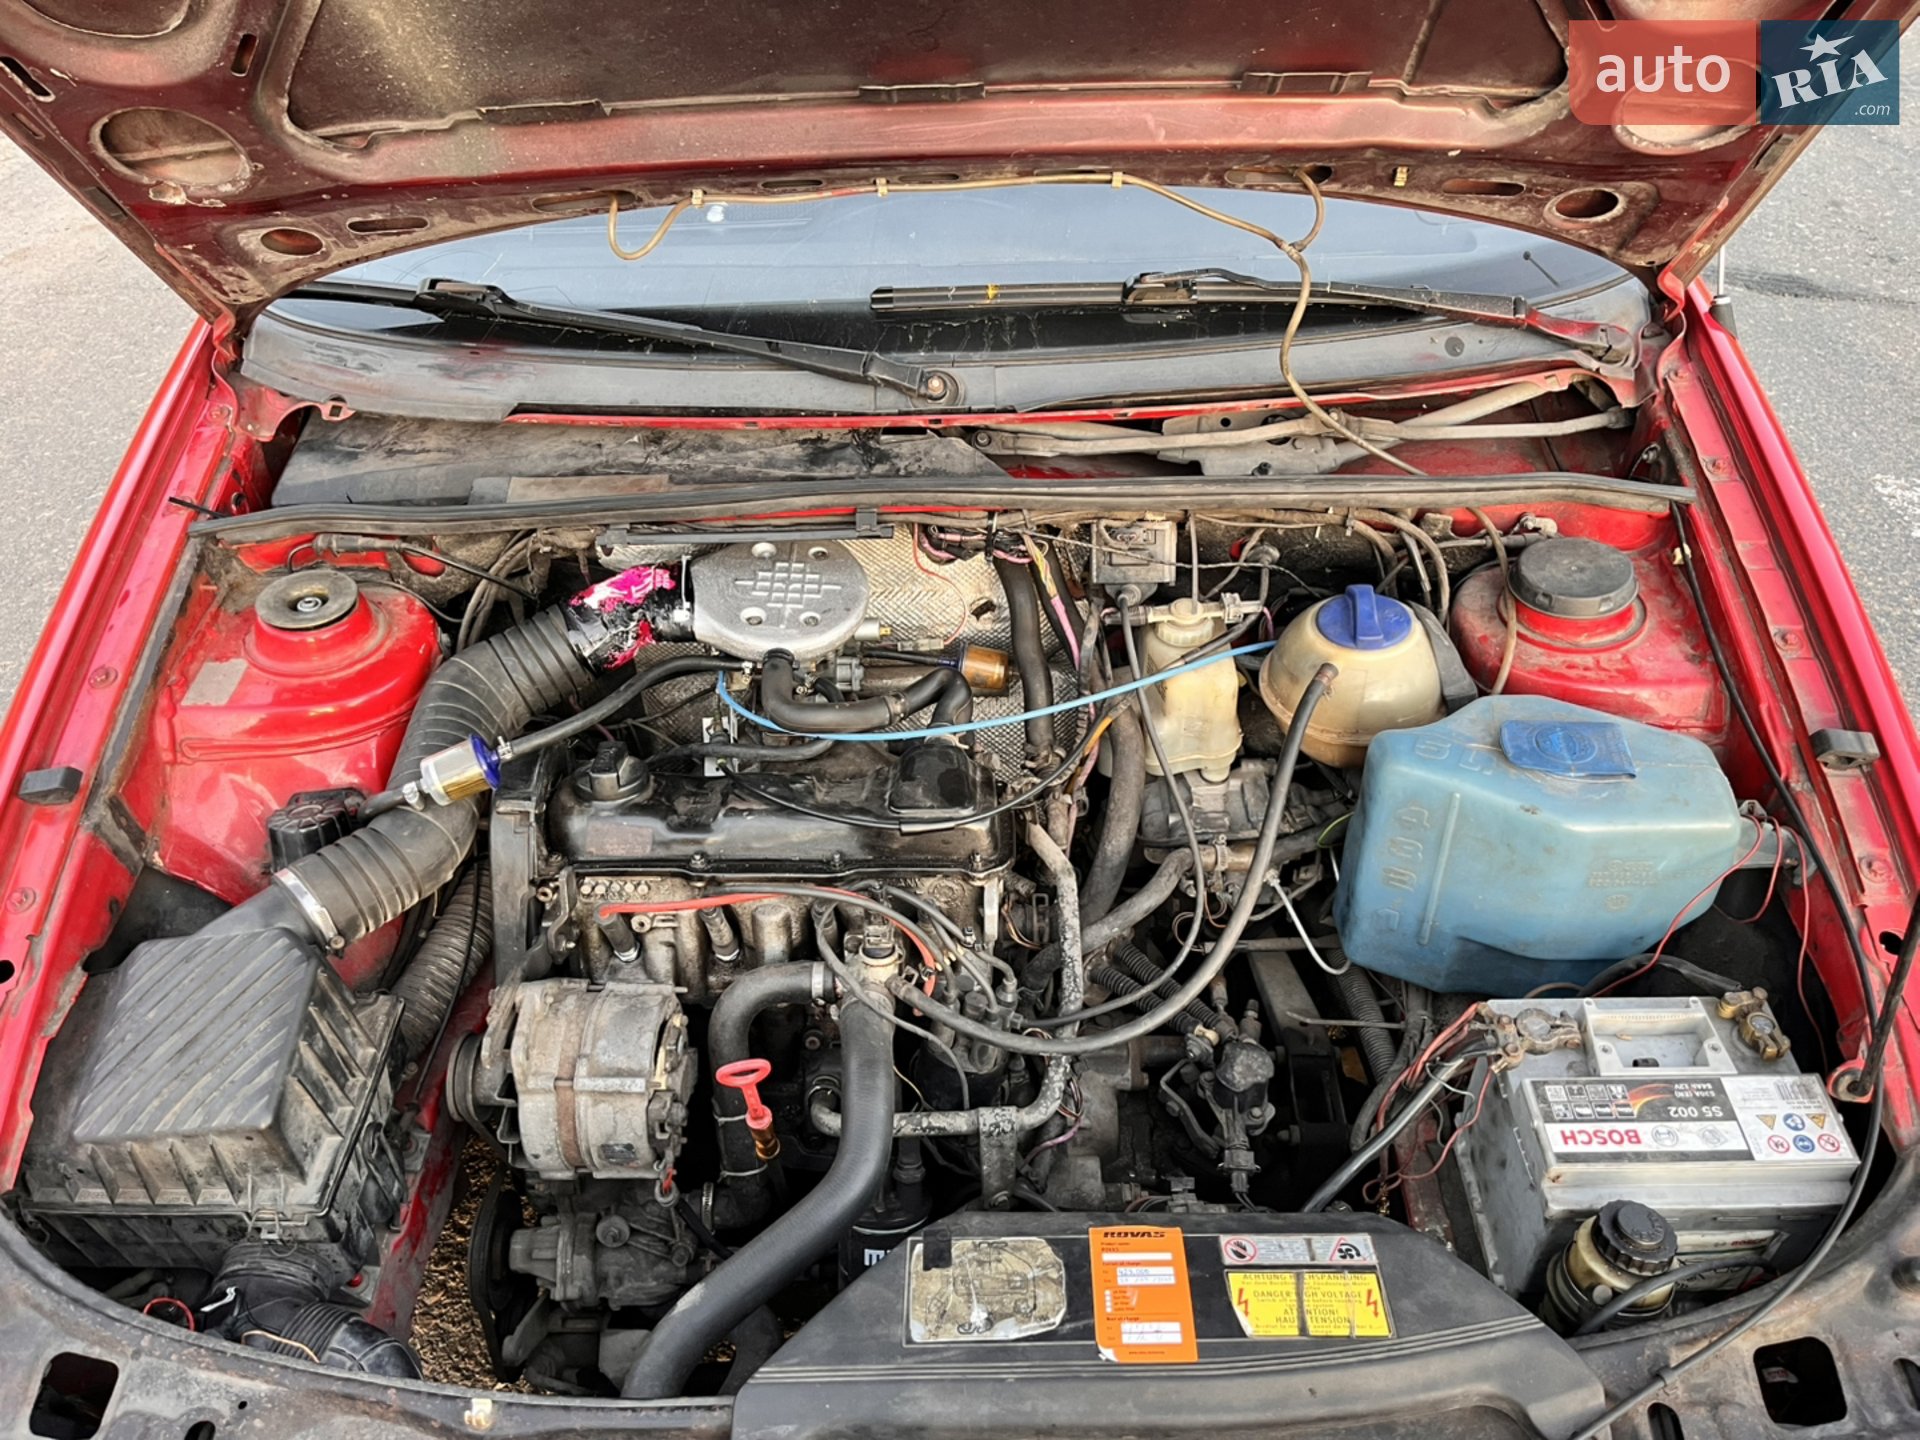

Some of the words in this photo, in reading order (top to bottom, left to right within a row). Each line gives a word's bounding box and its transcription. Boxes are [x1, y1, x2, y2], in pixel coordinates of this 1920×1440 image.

[1667, 1105, 1699, 1118] 002
[1701, 1105, 1724, 1117] S5
[1560, 1129, 1643, 1146] BOSCH
[1310, 1316, 1351, 1324] TENSION
